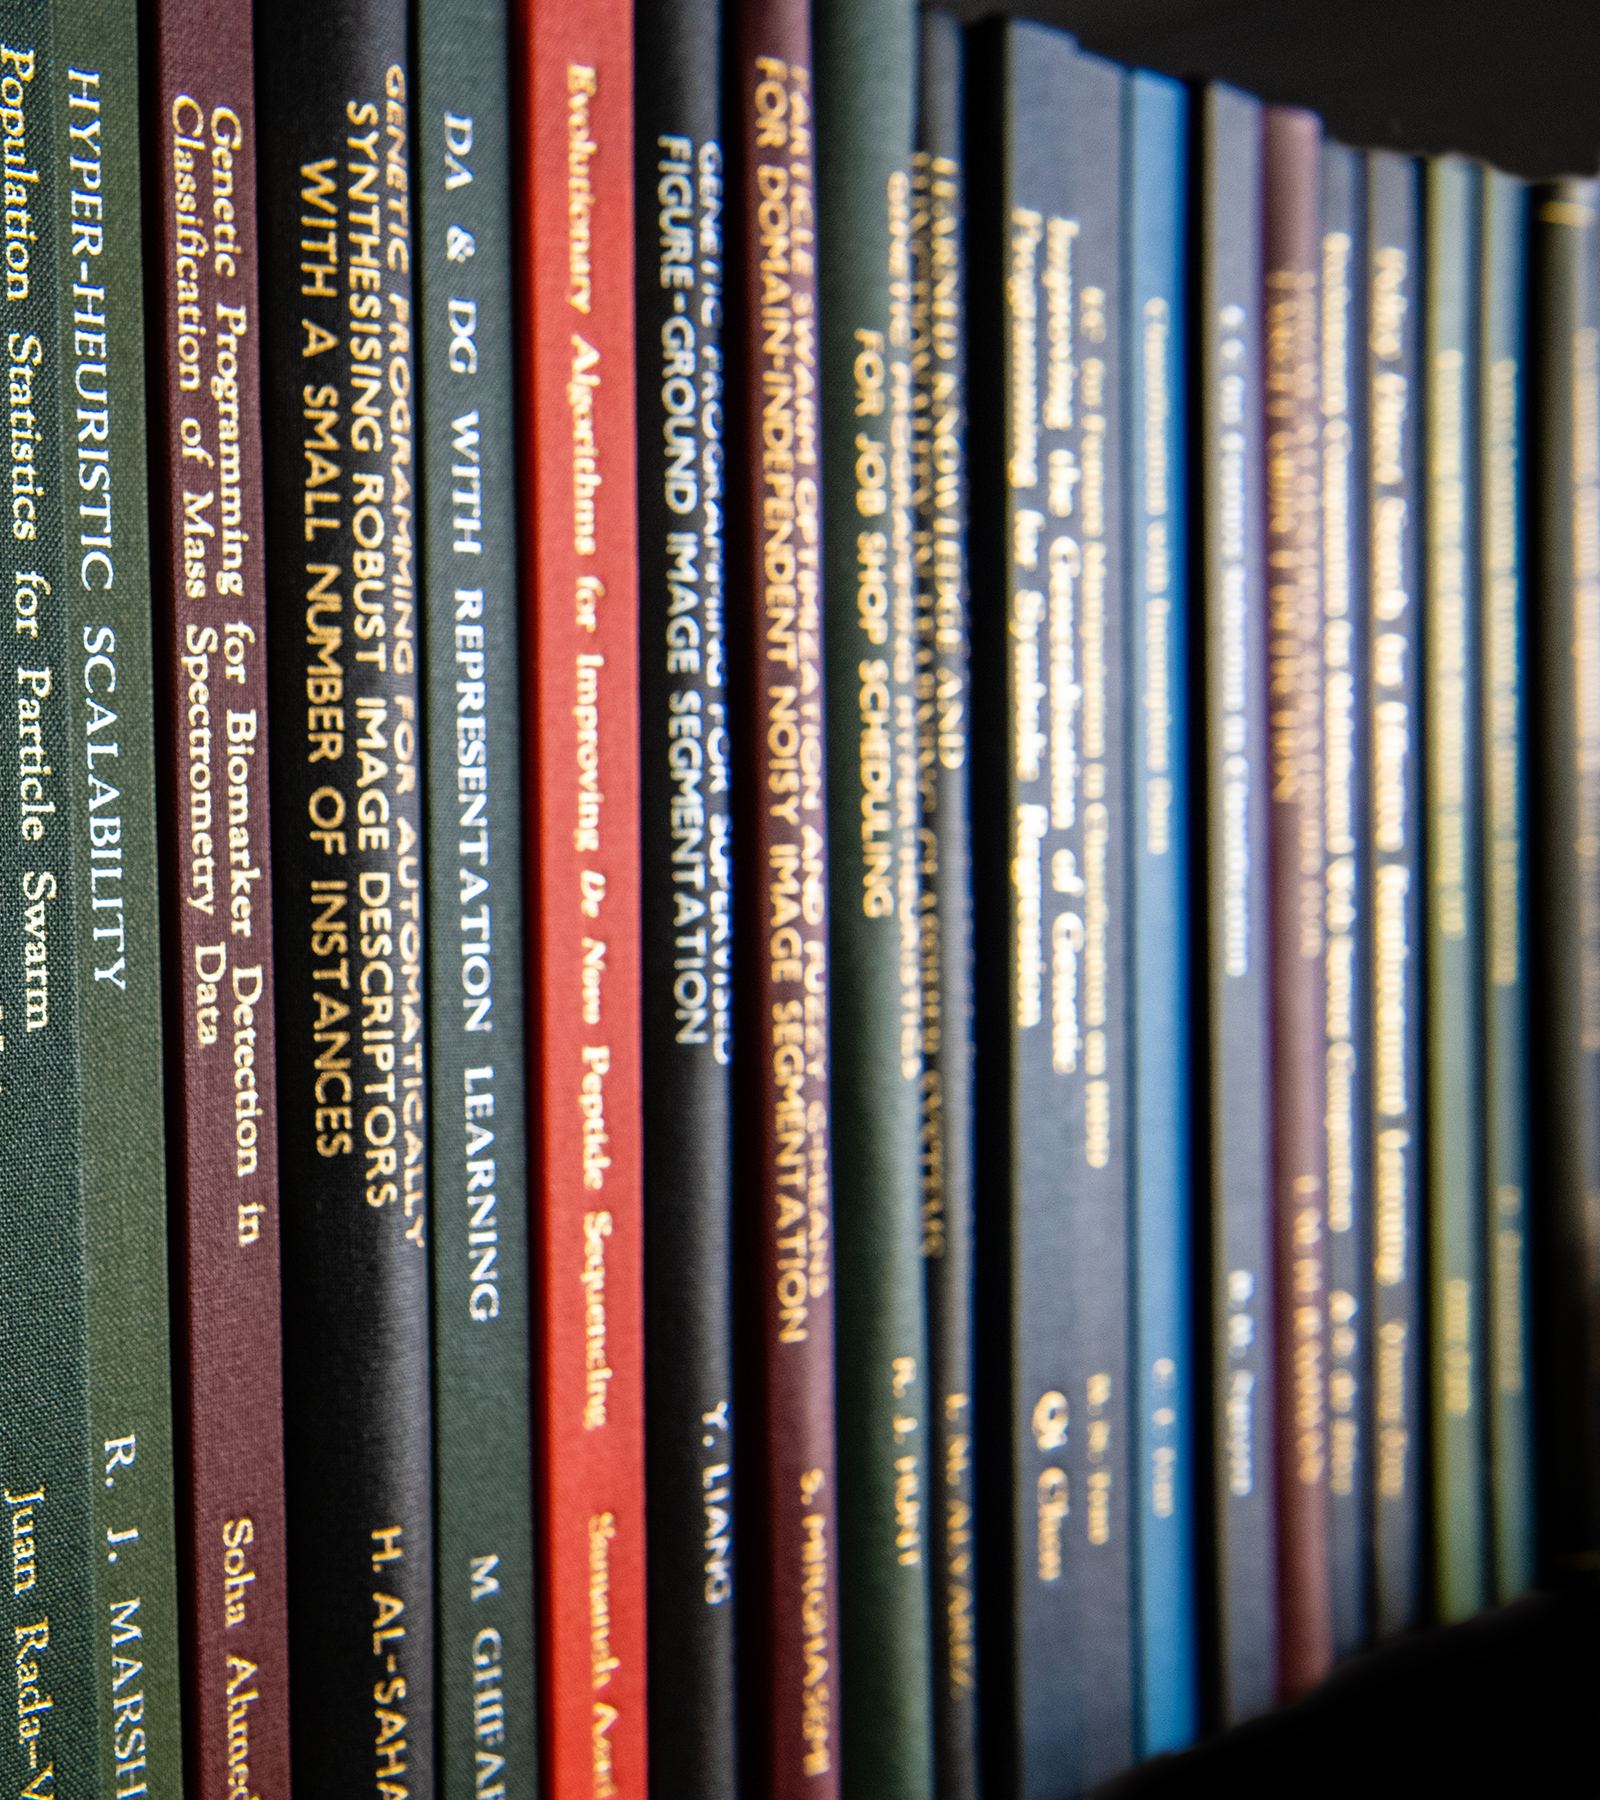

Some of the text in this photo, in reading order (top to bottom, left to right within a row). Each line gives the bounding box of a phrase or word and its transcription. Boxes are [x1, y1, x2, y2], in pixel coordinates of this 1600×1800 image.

[567, 64, 597, 314] Evolutionary
[7, 334, 45, 542] Statistics
[68, 67, 127, 991] HYPER-HEURISTIC SCALABILITY
[568, 333, 602, 556] Algorithms
[13, 571, 51, 638] for
[171, 95, 227, 1046] Classification of Mass Spectrometry Data
[210, 106, 265, 1247] Genetic Programming for Biomarker Detection in
[300, 158, 353, 1158] WITH A SMALL NUMBER OF INSTANCES
[346, 100, 398, 1207] SYNTHESISING ROBUST IMAGE DESCRIPTORS
[386, 65, 425, 1248] GENETIC PROGRAMMING FOR AUTOMATICALLY
[575, 576, 606, 632] for
[657, 133, 708, 1046] FIGURE-GROUND IMAGE SEGMENTATION
[854, 329, 894, 919] FOR JOB SHOP SCHEDULING
[16, 666, 55, 842] Particle
[444, 111, 500, 1322] DA & DG WITH REPRESENTATION LEARNING
[572, 653, 606, 853] Improving
[754, 56, 808, 1343] FOR DOMAIN-INDEPENDENT NOISY IMAGE SEGMENTATION
[20, 870, 56, 1031] Swarm
[582, 1046, 611, 1191] Peptide
[580, 1210, 614, 1430] Sequencing
[4, 1484, 47, 1595] Juan
[222, 1518, 256, 1629] Soha
[371, 1526, 404, 1574] H.
[470, 1554, 499, 1600] M
[702, 1401, 731, 1605] Y. LIANG
[104, 1434, 148, 1800] R. J. MARSH
